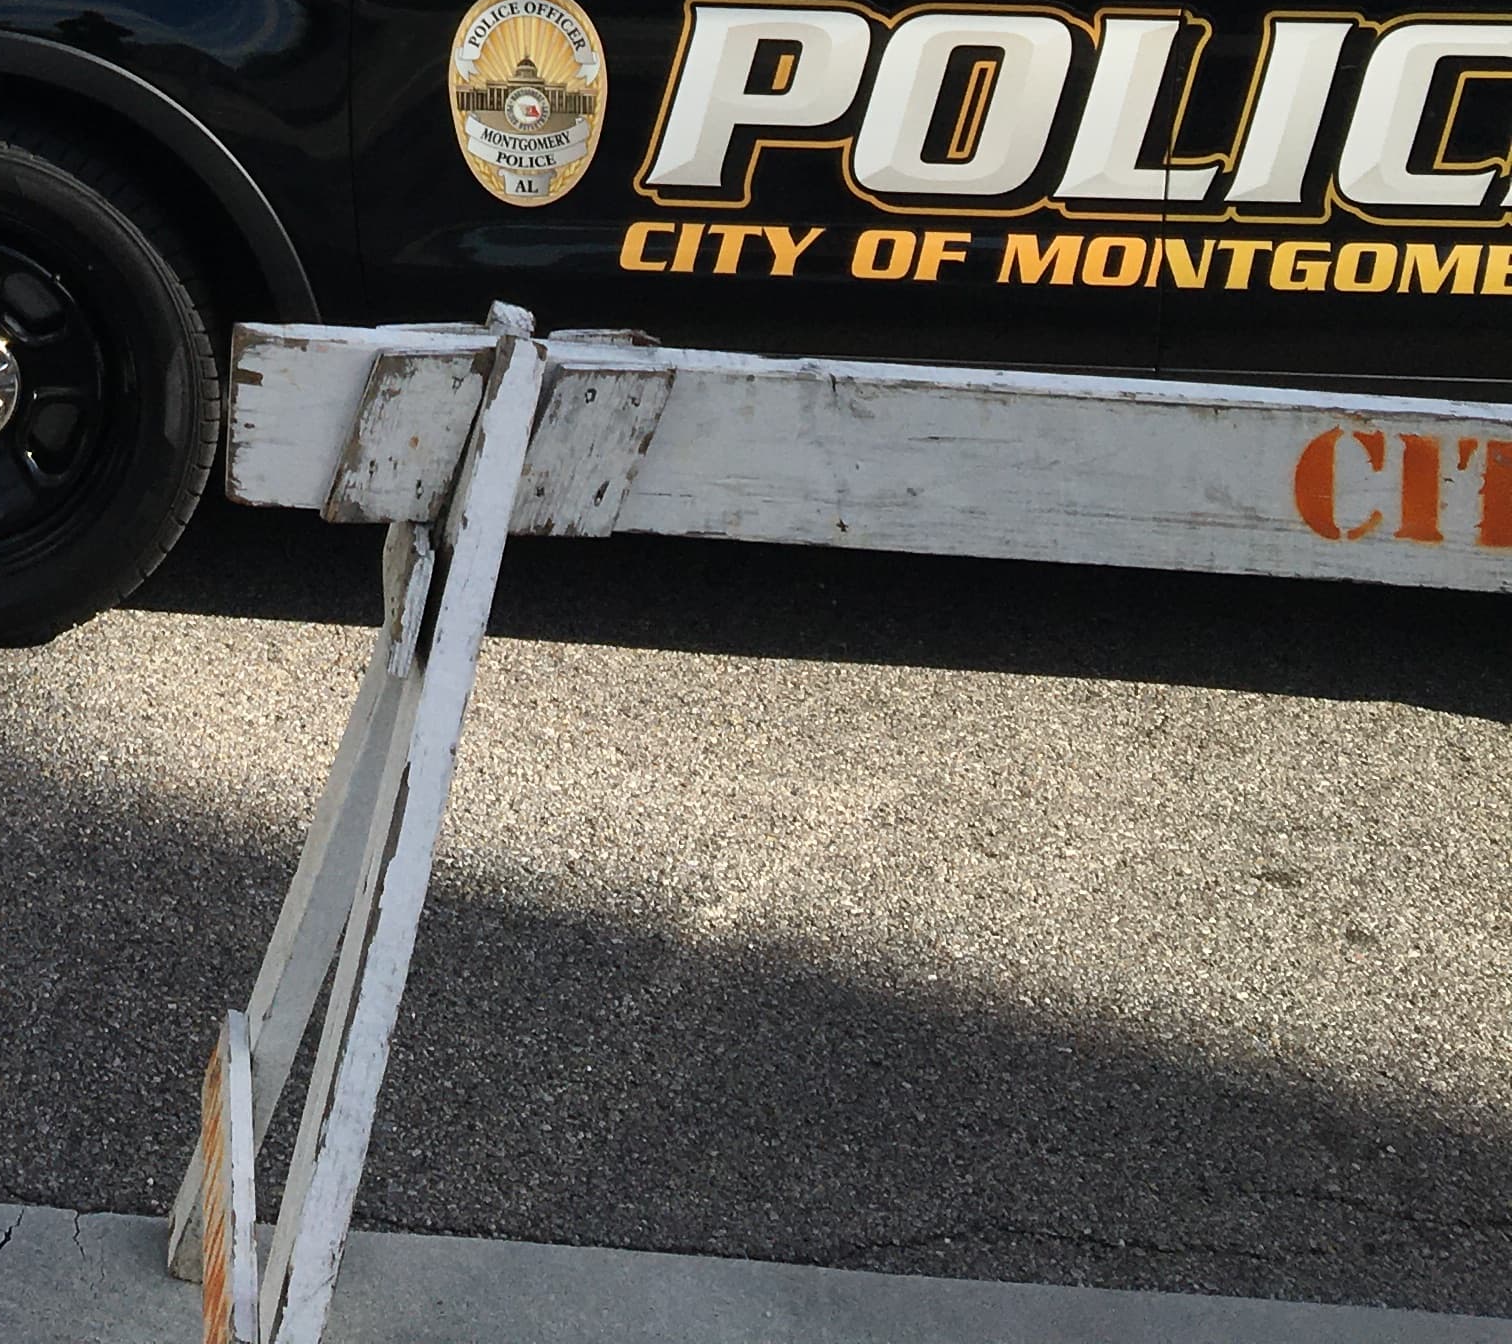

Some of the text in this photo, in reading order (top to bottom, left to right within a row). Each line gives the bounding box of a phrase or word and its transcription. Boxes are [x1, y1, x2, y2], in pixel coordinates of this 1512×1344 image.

[468, 1, 586, 51] POLICE OFFICER
[645, 5, 1512, 208] POLIC
[480, 128, 571, 152] MONTGOMERY
[496, 152, 557, 169] POLICE
[515, 179, 539, 194] AL
[619, 221, 826, 277] CITY
[851, 229, 972, 281] OF
